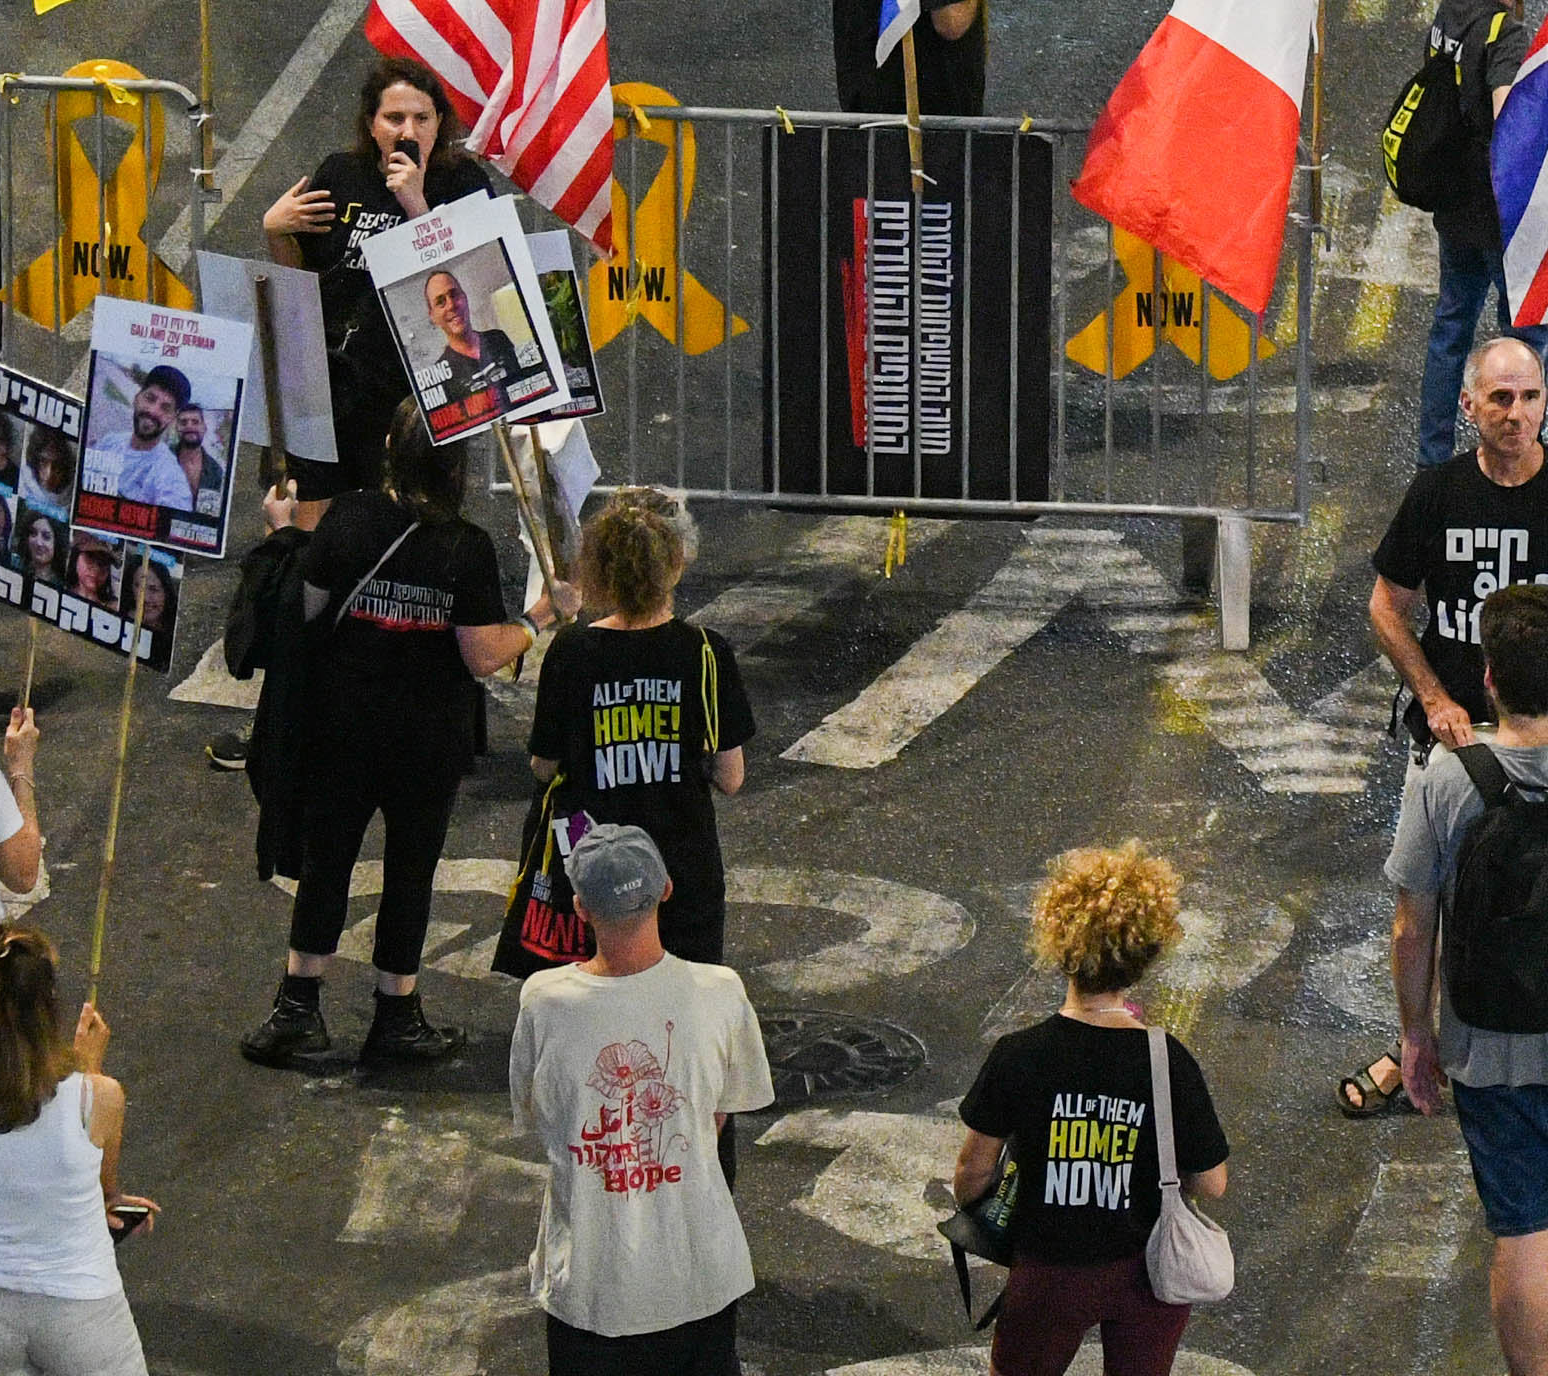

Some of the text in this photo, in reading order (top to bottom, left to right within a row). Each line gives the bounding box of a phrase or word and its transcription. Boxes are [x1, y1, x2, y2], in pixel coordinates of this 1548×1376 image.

[420, 249, 441, 264] (50)
[416, 360, 453, 390] BRING
[421, 384, 448, 411] HIM
[1446, 528, 1529, 572] חיים
[1437, 599, 1484, 644] Lif
[593, 681, 623, 707] ALL
[633, 678, 682, 703] THEM
[594, 705, 681, 746] HOME!
[595, 741, 681, 790] NOW!
[1052, 1093, 1087, 1119] ALL
[1098, 1094, 1146, 1127] THEM
[1048, 1120, 1139, 1164] HOME!
[604, 1161, 682, 1193] Hope
[1044, 1160, 1133, 1210] NOW!
